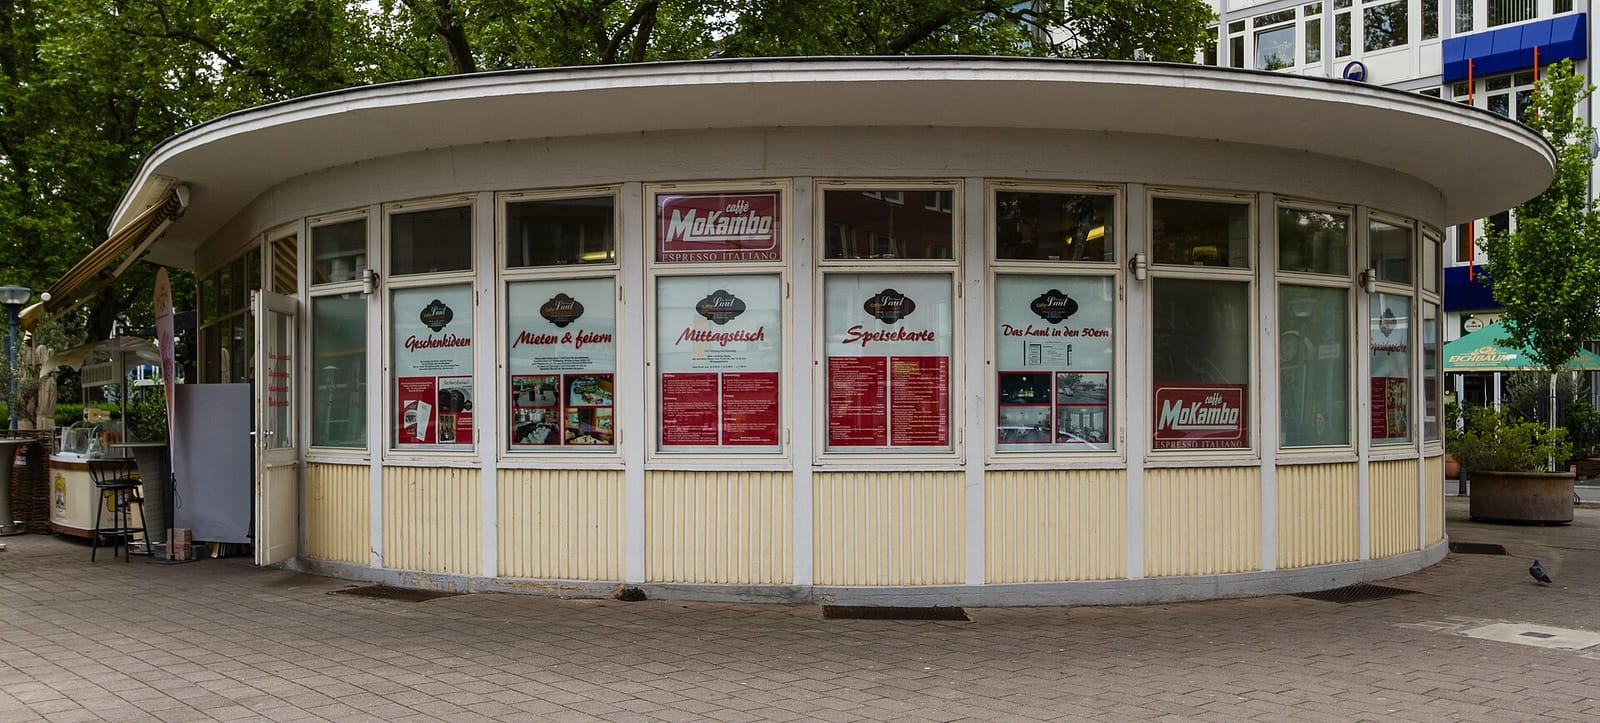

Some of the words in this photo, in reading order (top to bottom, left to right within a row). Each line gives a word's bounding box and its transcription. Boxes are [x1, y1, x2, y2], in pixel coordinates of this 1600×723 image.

[662, 252, 717, 262] ESPRESSO
[722, 251, 777, 261] ITALIANO
[512, 330, 558, 349] Mieten
[561, 331, 573, 345] &
[575, 329, 612, 350] feiern
[675, 326, 765, 347] Mittagstisch
[841, 325, 936, 348] Speisekarte
[1001, 324, 1023, 337] Das
[1051, 328, 1060, 337] in
[1063, 326, 1079, 337] den
[1081, 328, 1109, 338] 50ern
[404, 333, 471, 353] Geschenkideen
[1155, 441, 1199, 449] ESPRESSO
[1202, 440, 1242, 448] ITALIANO
